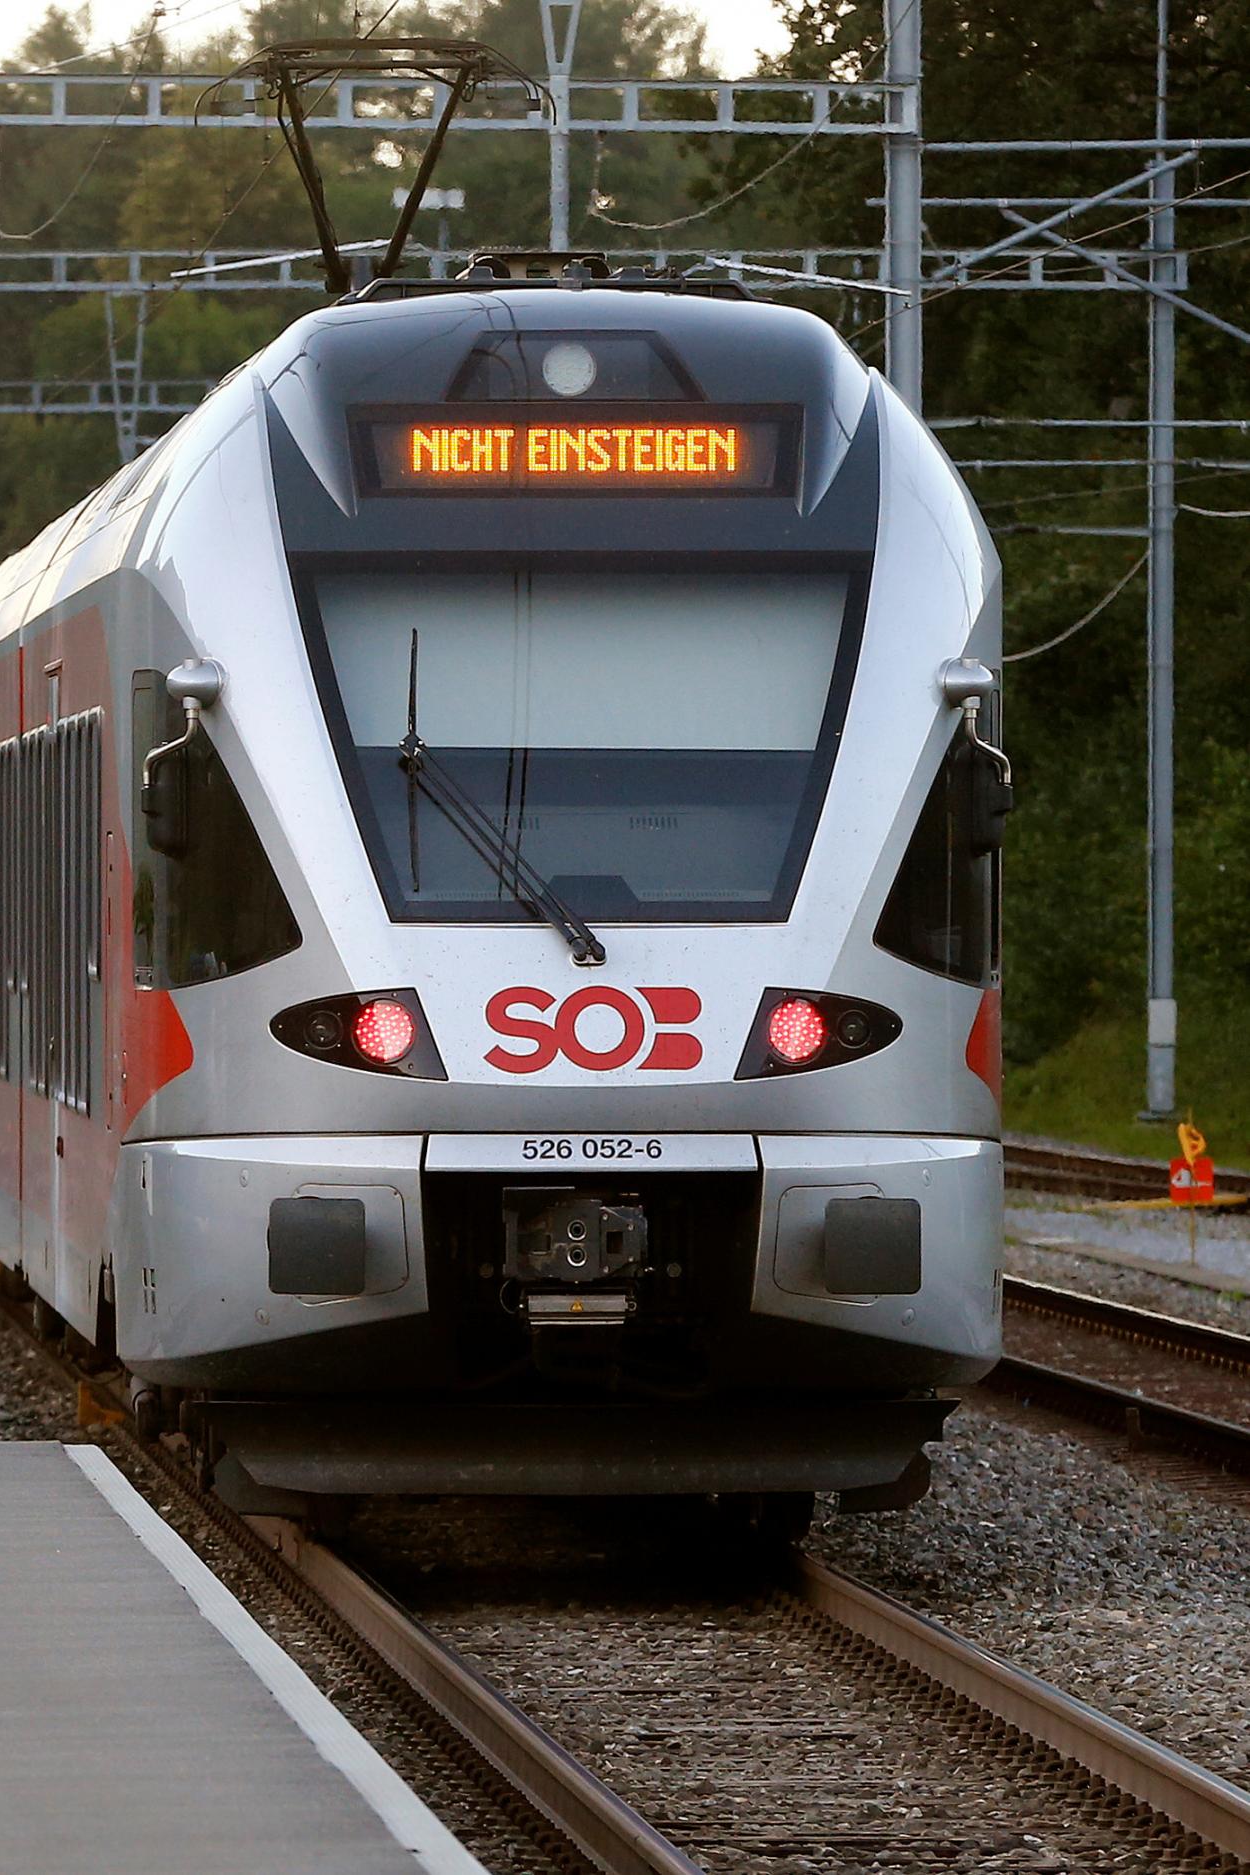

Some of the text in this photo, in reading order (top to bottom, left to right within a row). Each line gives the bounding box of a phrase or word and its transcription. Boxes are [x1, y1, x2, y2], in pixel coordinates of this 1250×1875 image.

[412, 427, 736, 472] NICHT EINSTEIGEN
[483, 985, 703, 1074] SOB
[522, 1139, 662, 1159] 526 052-6
